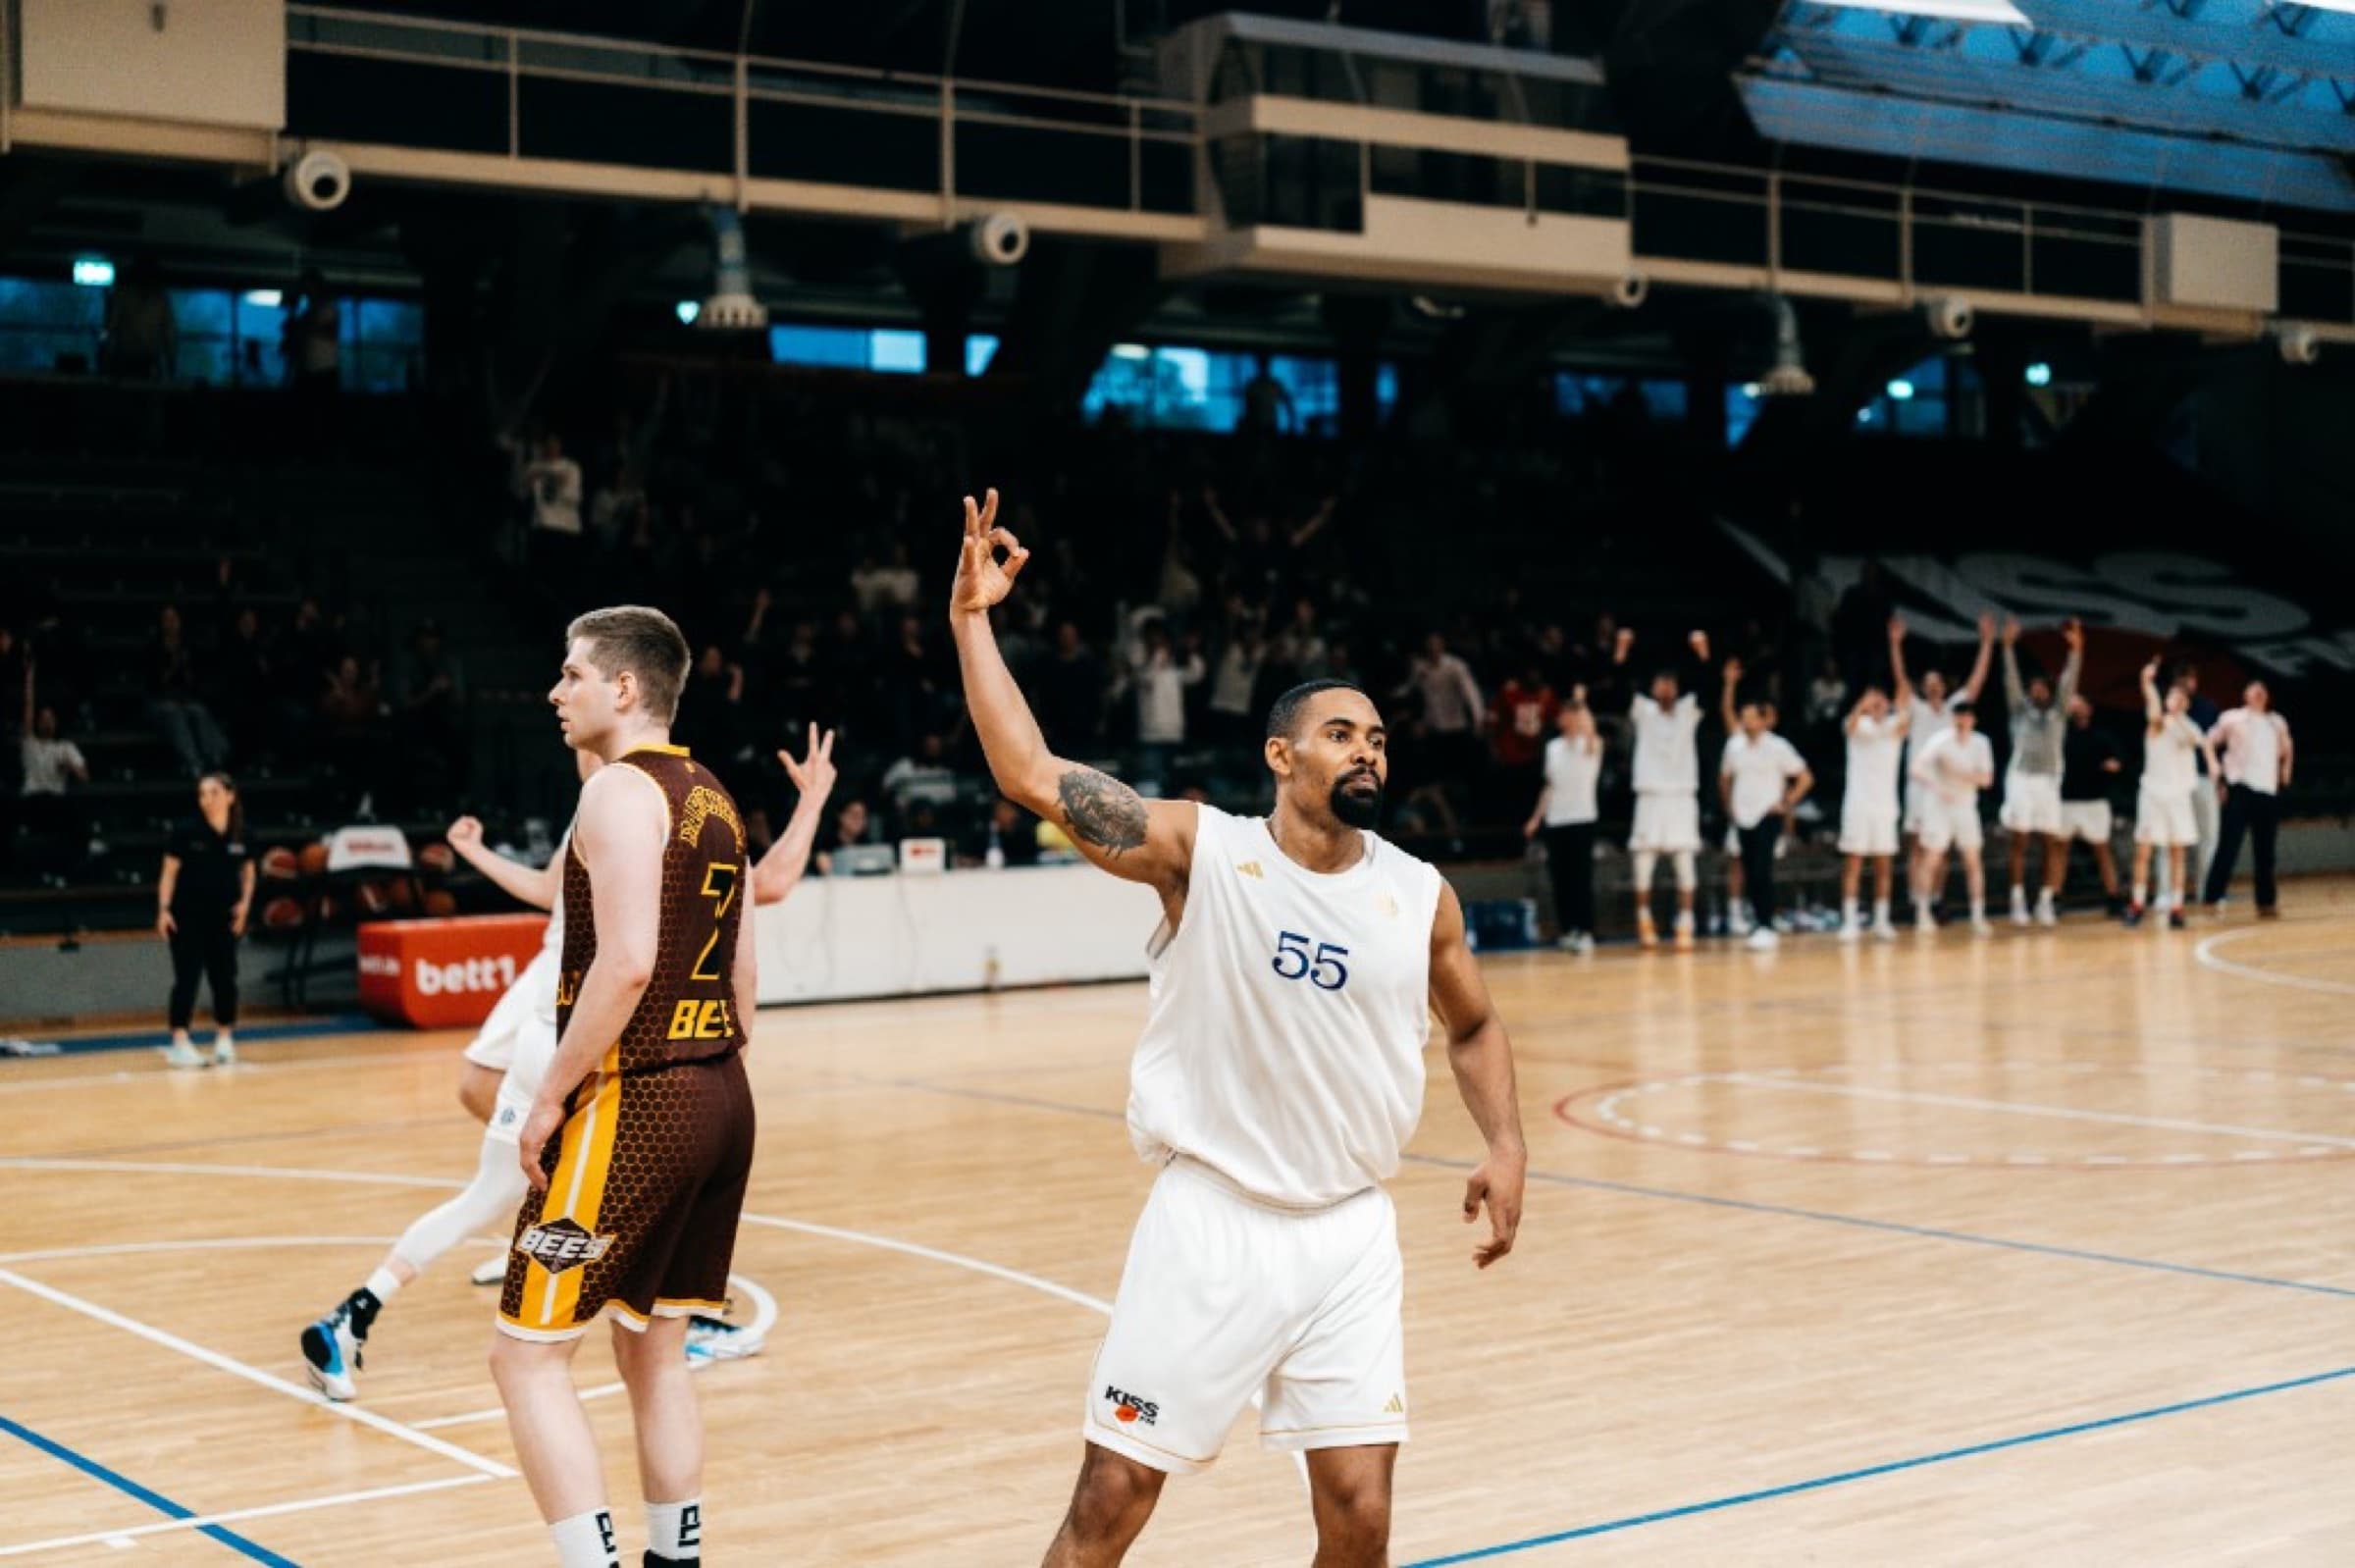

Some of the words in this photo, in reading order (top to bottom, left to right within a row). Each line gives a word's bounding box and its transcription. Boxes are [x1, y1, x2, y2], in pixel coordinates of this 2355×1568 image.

[1272, 930, 1349, 991] 55
[517, 1225, 614, 1260] BEES
[1105, 1385, 1159, 1418] KISS
